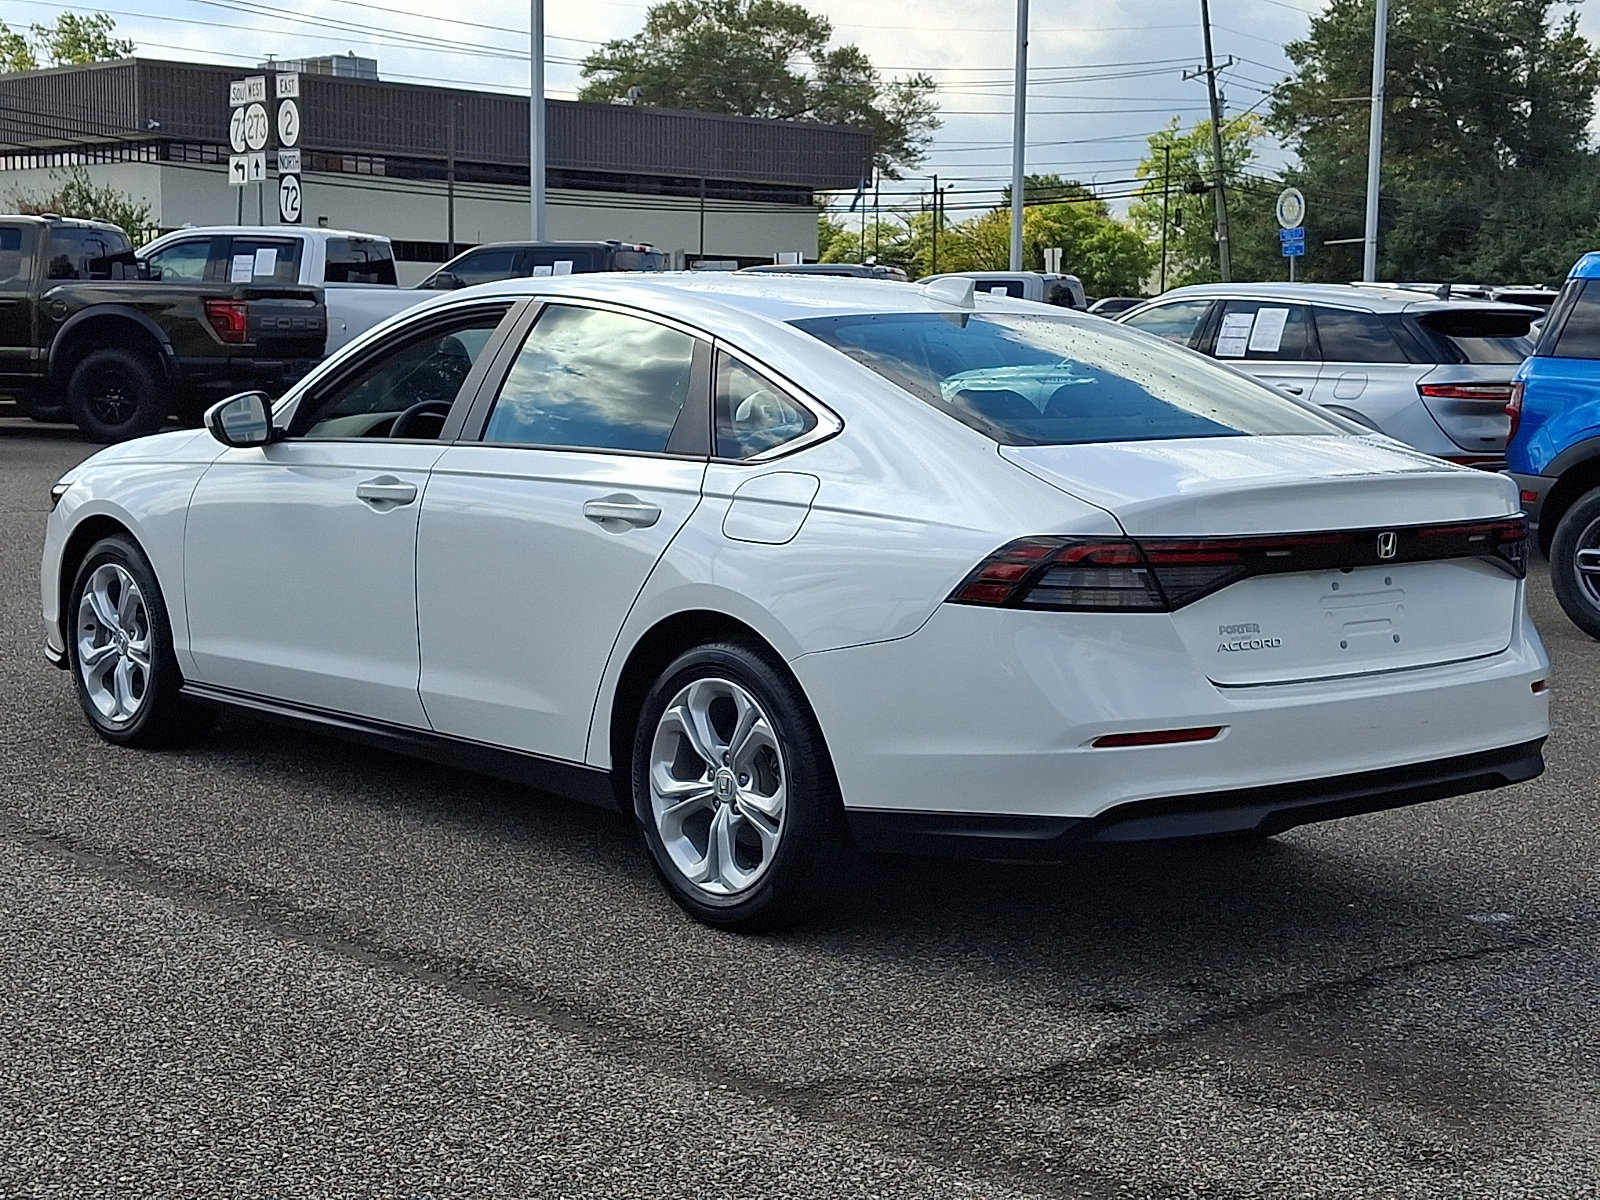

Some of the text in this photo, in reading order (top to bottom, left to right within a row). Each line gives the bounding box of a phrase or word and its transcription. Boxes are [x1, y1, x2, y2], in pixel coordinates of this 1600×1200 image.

[248, 82, 263, 97] WEST
[280, 79, 295, 94] EAST
[247, 113, 267, 139] 273
[284, 110, 293, 136] 2
[279, 155, 300, 170] NORTH
[282, 186, 299, 212] 72
[259, 317, 320, 330] FORD
[1218, 623, 1260, 635] PORTER
[1217, 638, 1282, 652] ACCORD
